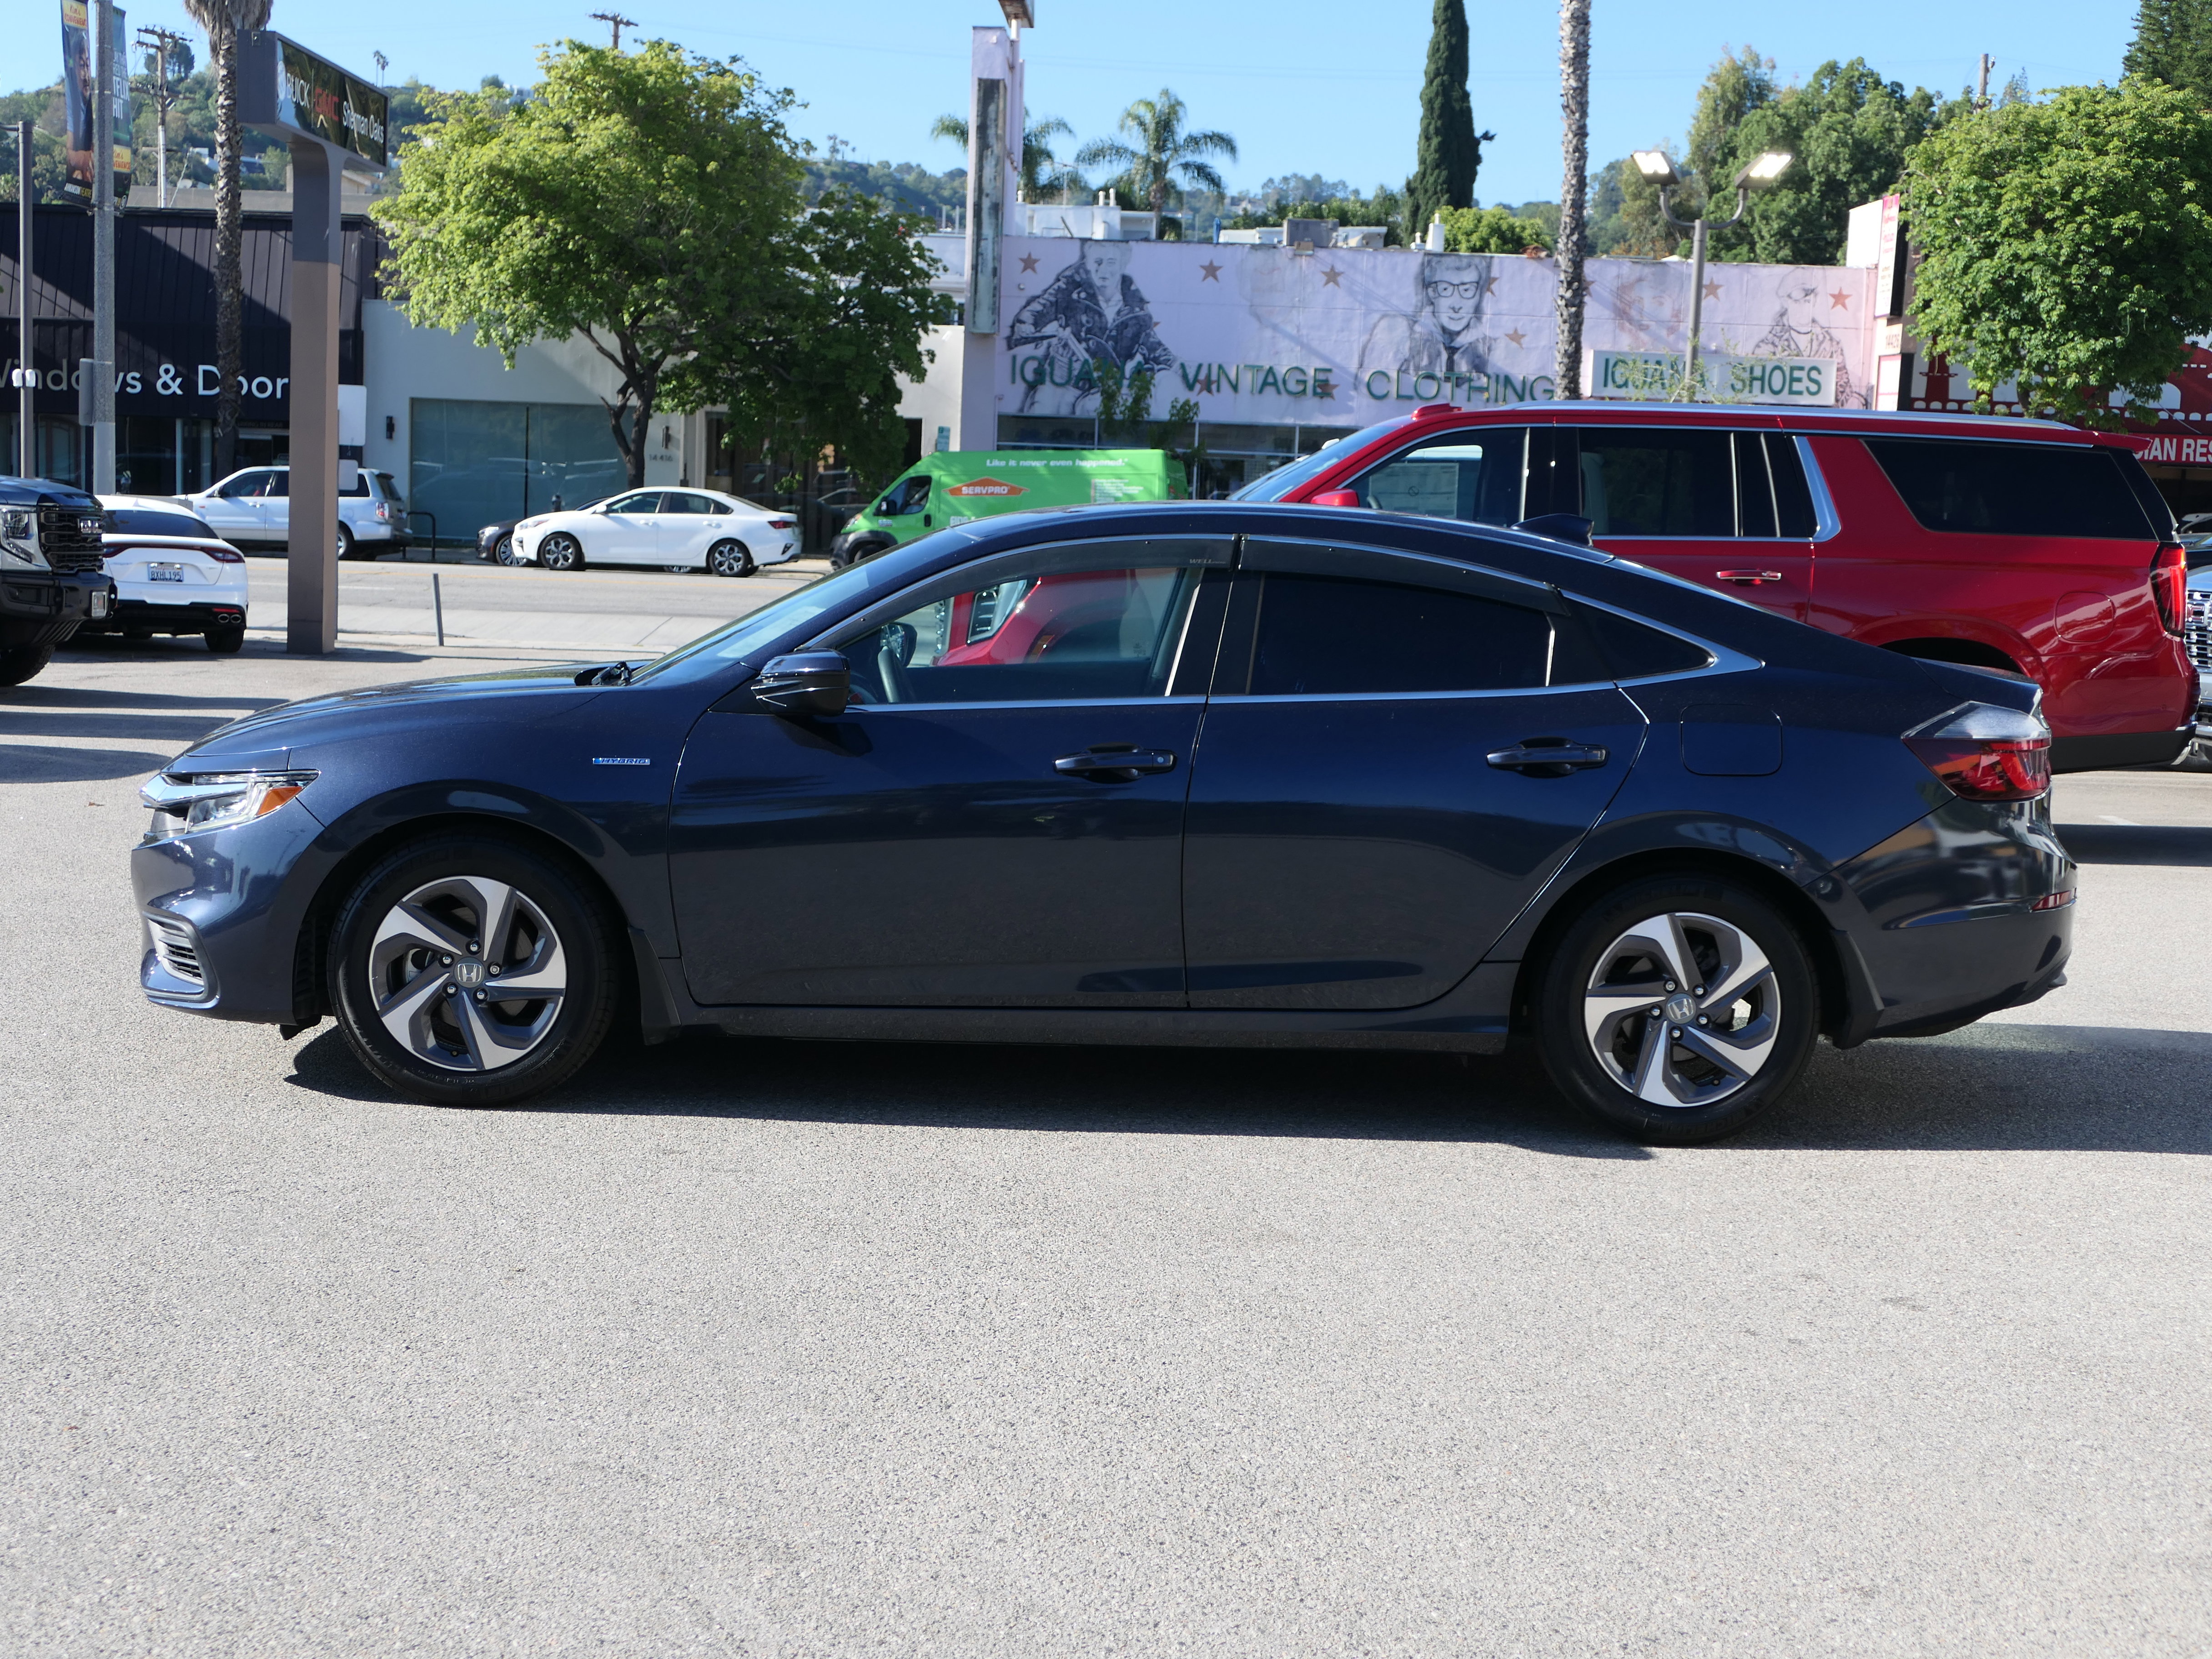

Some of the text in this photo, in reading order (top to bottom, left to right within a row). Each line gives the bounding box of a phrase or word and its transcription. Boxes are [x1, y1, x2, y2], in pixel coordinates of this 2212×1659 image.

[113, 75, 130, 102] TFLIX
[287, 72, 340, 122] BUICK GMC
[113, 97, 123, 120] HIT
[342, 101, 384, 144] Sherman Oaks
[156, 363, 183, 396] &
[1180, 362, 1332, 397] VINTAGE
[1367, 369, 1555, 403] CLOTHING
[1731, 363, 1823, 396] SHOES
[961, 486, 1008, 495] SERVPRO
